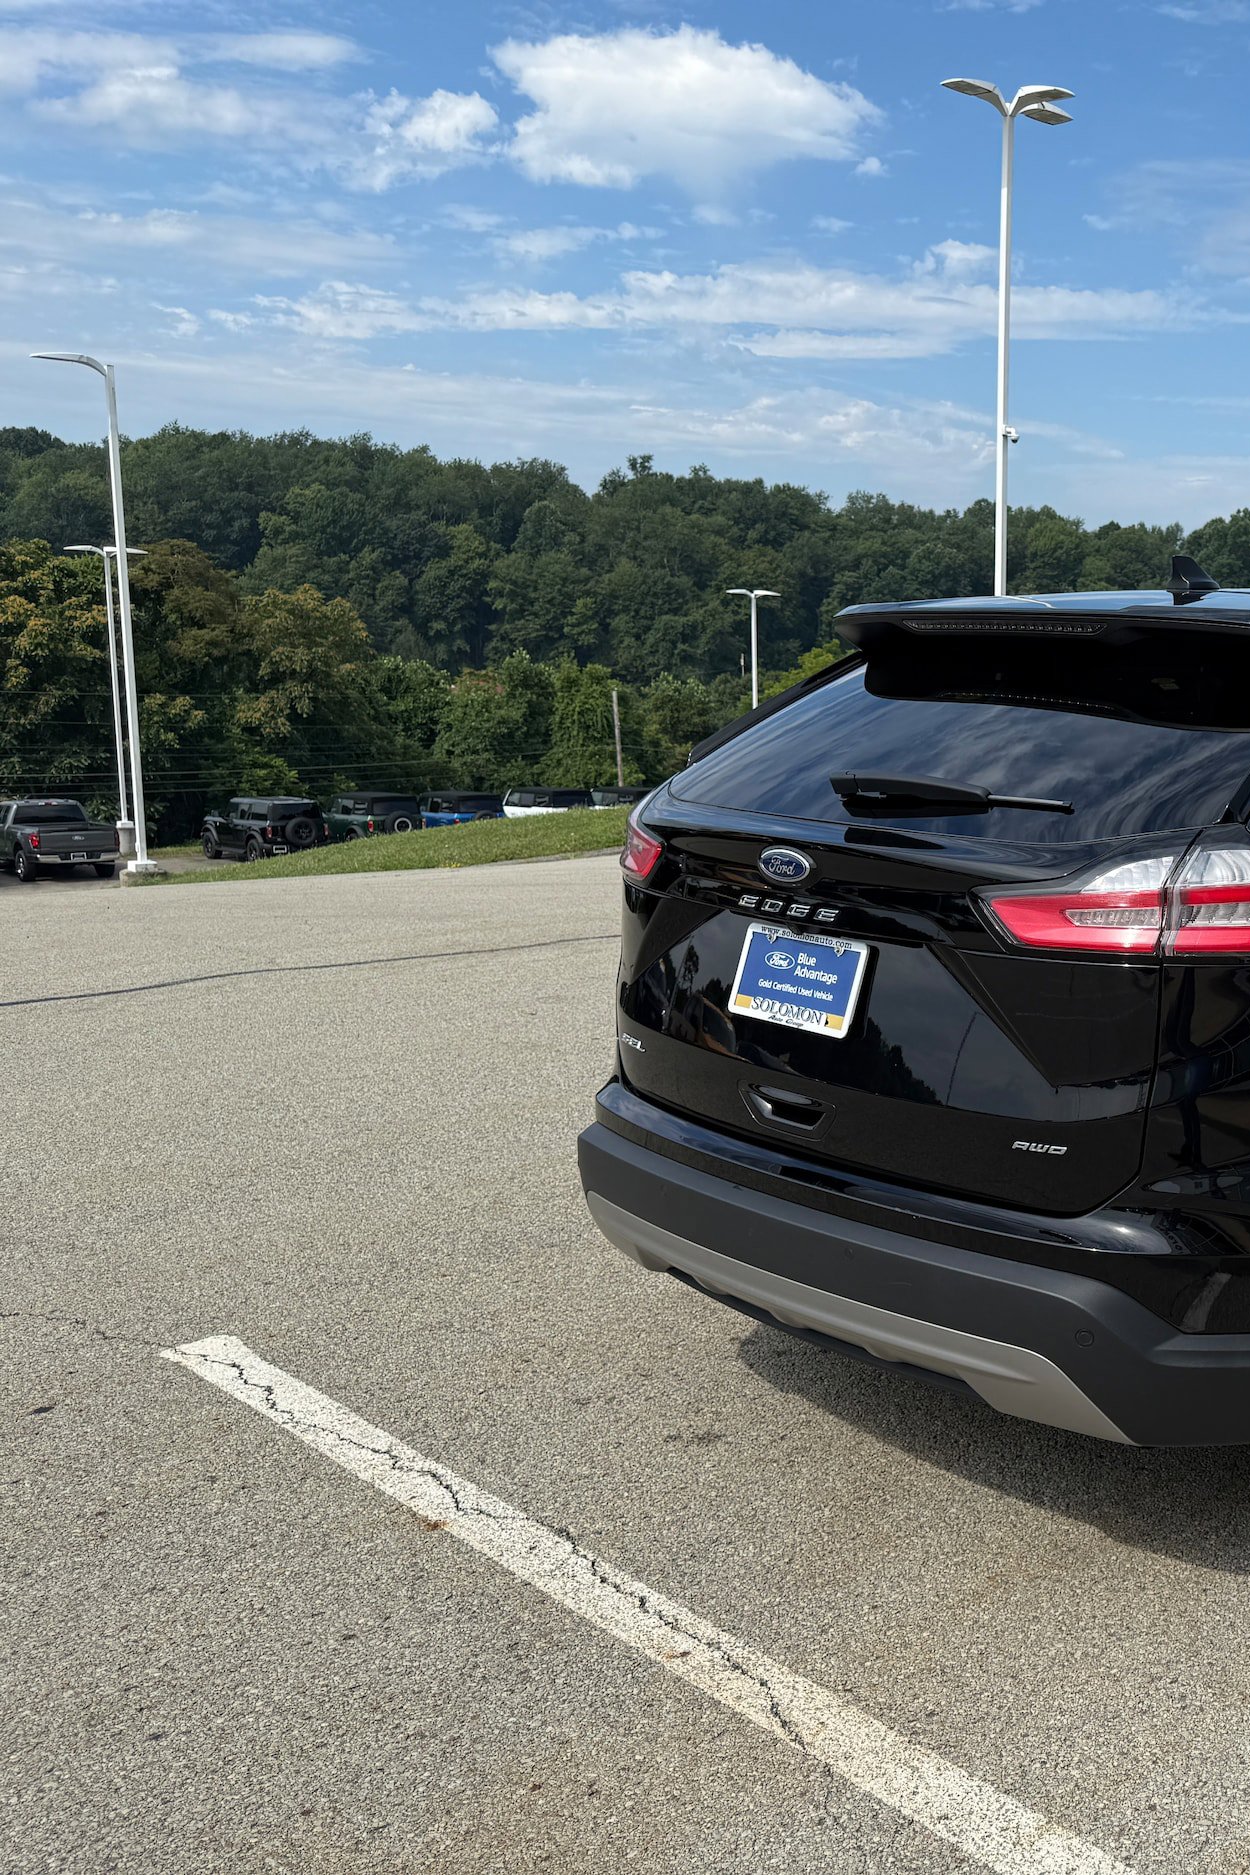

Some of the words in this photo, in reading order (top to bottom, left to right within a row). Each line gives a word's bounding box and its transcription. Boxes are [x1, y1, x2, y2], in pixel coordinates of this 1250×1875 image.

[768, 855, 796, 875] Ford
[738, 894, 839, 922] EDGE
[769, 953, 790, 967] Ford
[797, 952, 817, 966] Blue
[793, 966, 838, 985] Advantage
[758, 978, 773, 989] Gold
[772, 981, 798, 994] Certified
[797, 987, 814, 998] Used
[813, 990, 834, 1002] Vehicle
[751, 996, 824, 1025] SOLOMON
[1011, 1140, 1068, 1155] AWD
